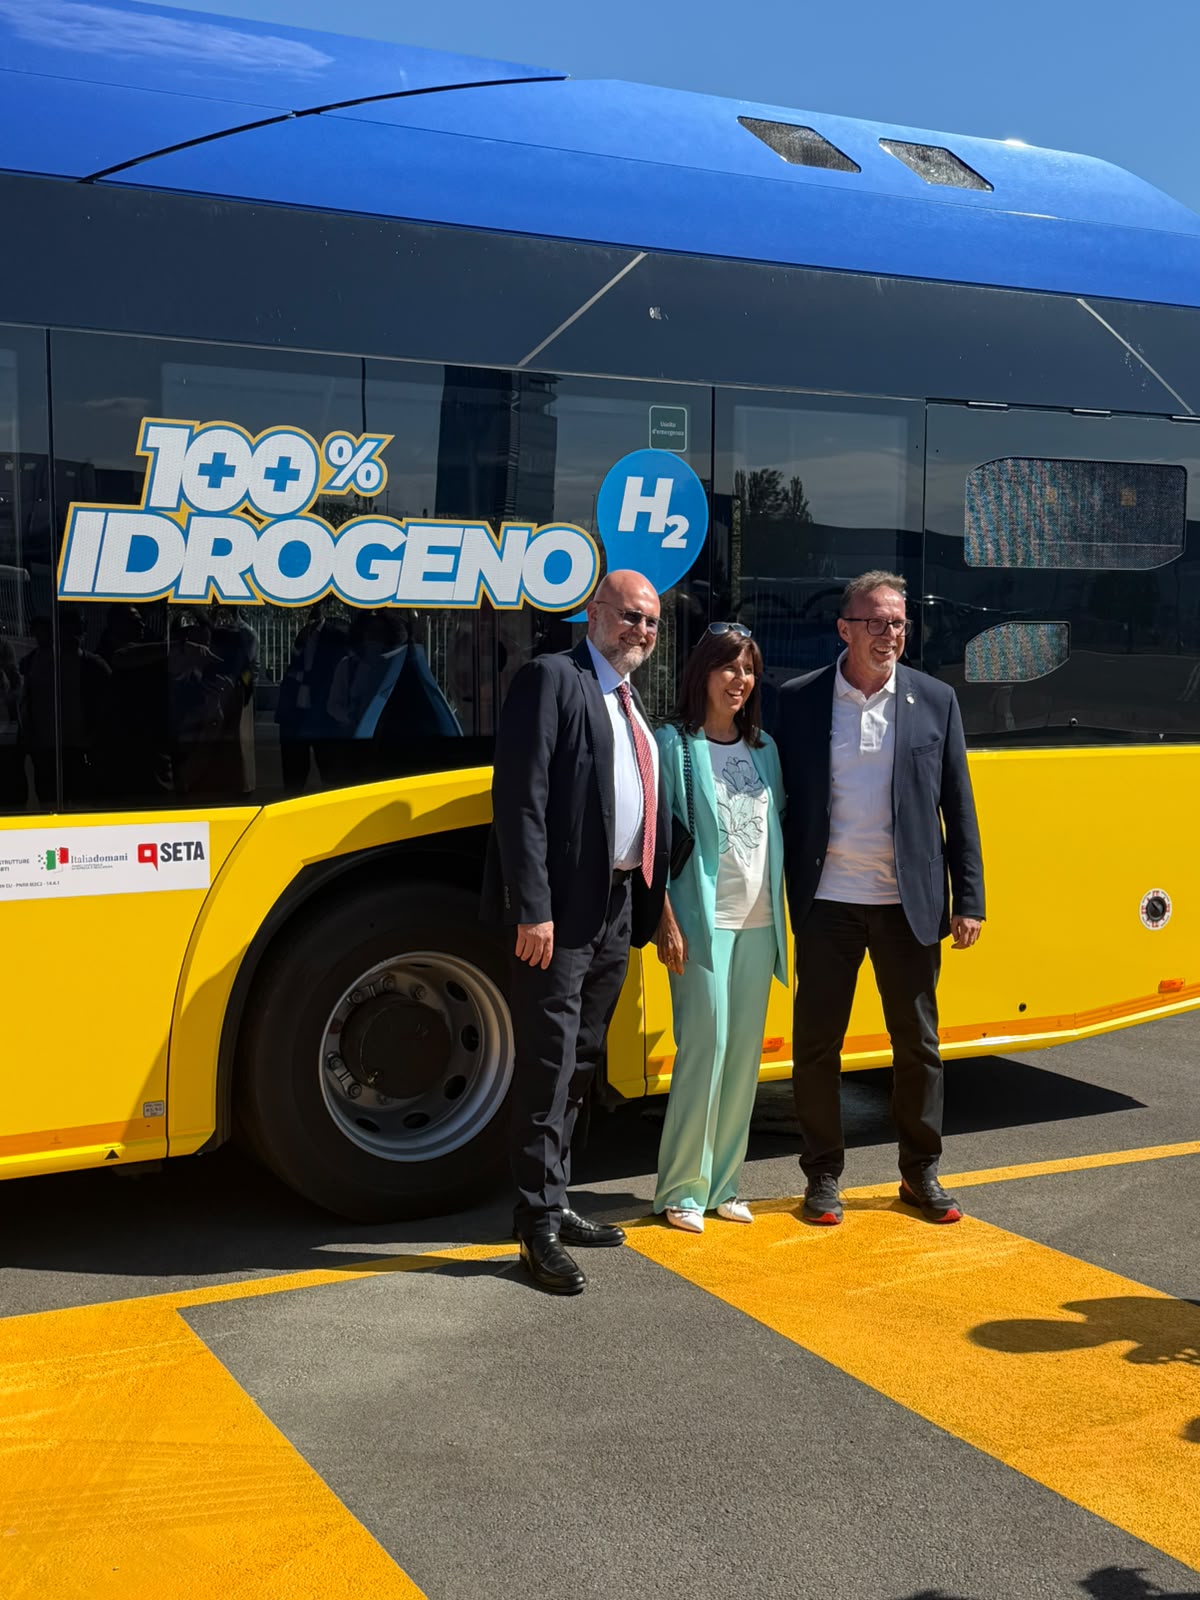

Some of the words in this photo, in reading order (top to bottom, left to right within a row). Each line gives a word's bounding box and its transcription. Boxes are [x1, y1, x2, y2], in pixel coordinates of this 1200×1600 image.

[142, 422, 386, 517] 100%
[617, 475, 690, 549] H2
[60, 507, 597, 607] IDROGENO
[71, 853, 128, 864] Italiadomani
[160, 841, 205, 863] SETA
